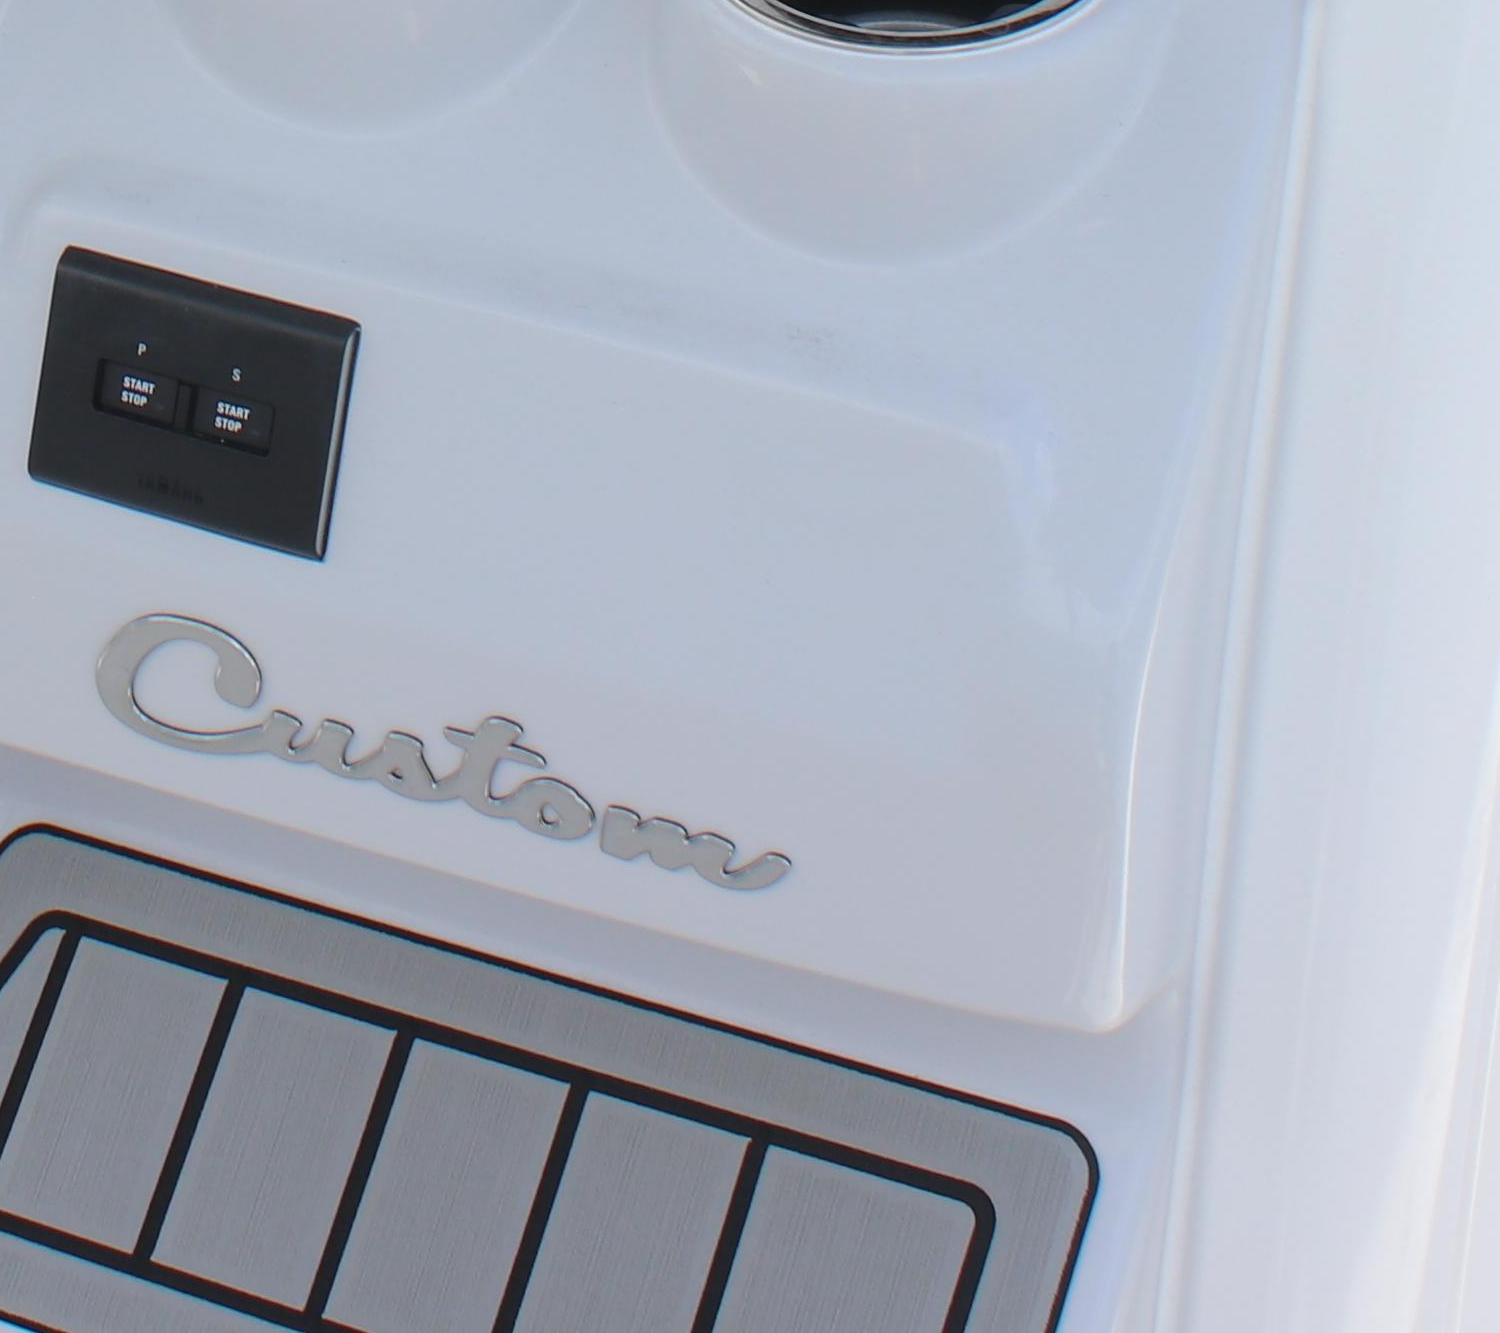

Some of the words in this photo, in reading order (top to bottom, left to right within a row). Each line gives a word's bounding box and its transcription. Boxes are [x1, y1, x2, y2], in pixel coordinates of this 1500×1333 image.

[138, 342, 147, 356] P
[232, 368, 241, 382] S
[122, 376, 155, 395] START
[121, 390, 147, 408] STOP
[216, 401, 250, 420] START
[214, 416, 242, 433] STOP
[95, 613, 792, 891] Custom
